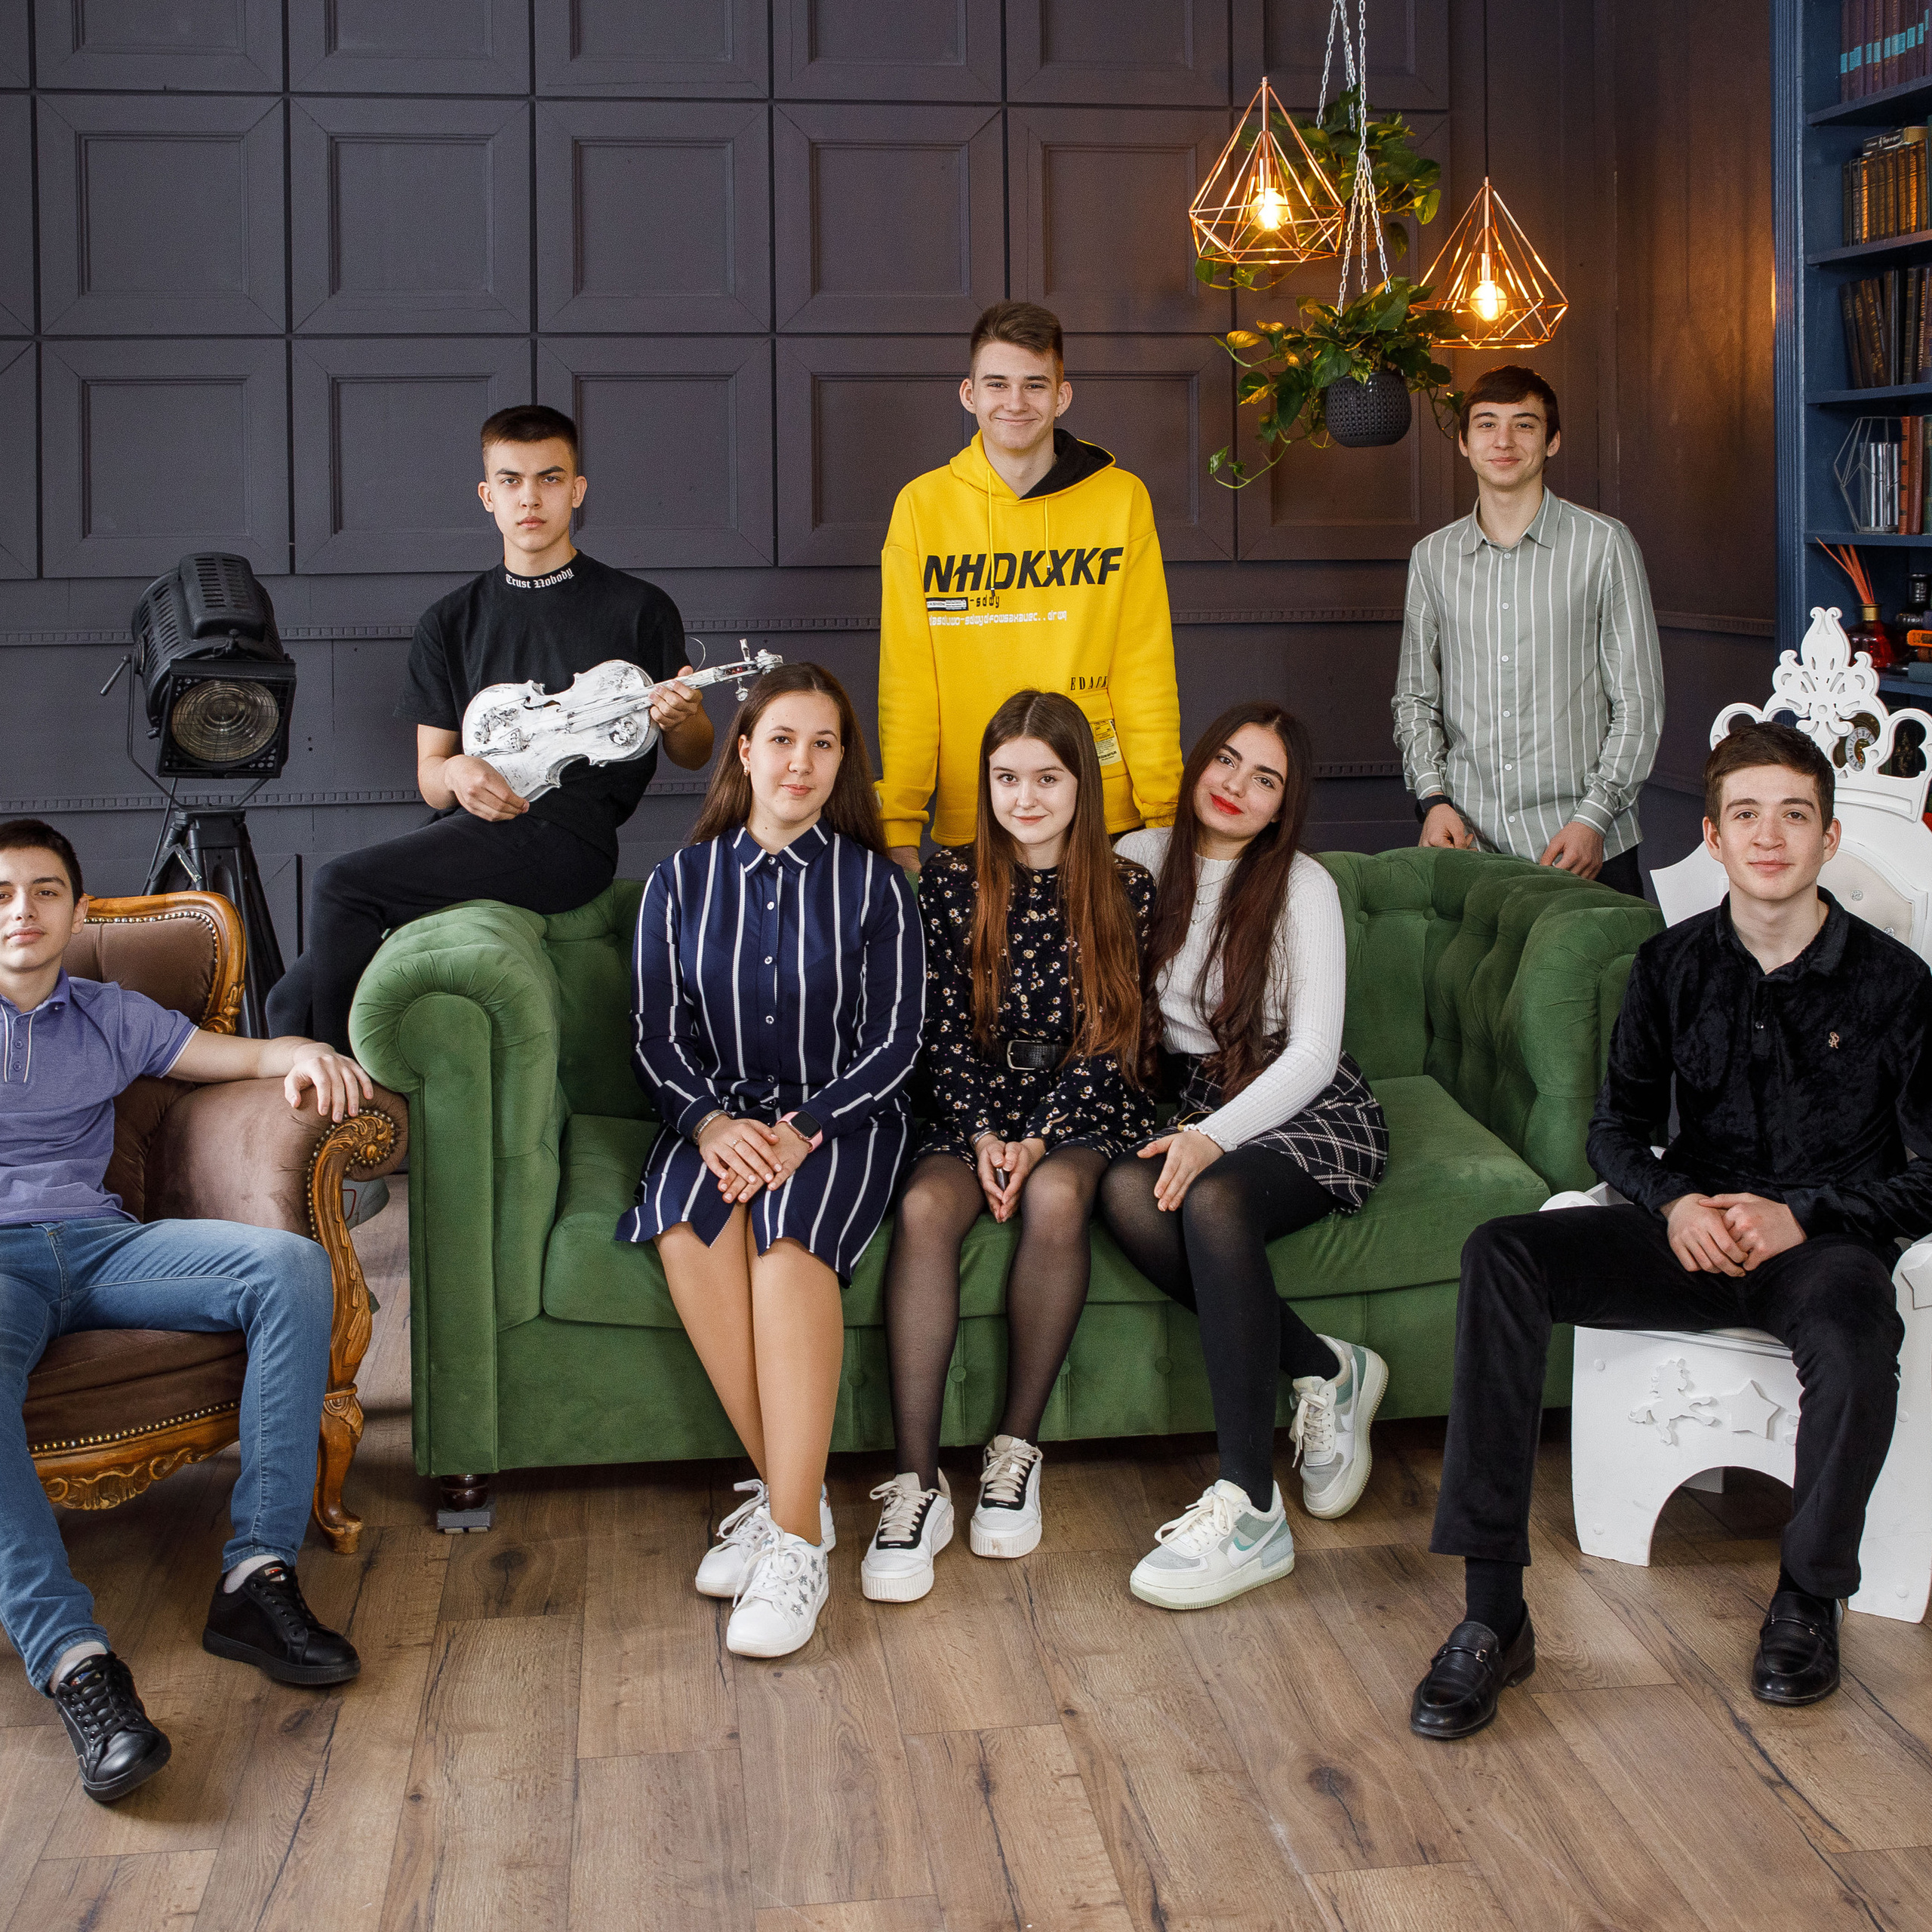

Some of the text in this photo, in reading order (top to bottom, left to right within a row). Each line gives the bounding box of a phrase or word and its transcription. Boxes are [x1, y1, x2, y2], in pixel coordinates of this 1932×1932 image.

[505, 568, 575, 589] Trust Nobody
[924, 546, 1124, 592] NHDKXKF
